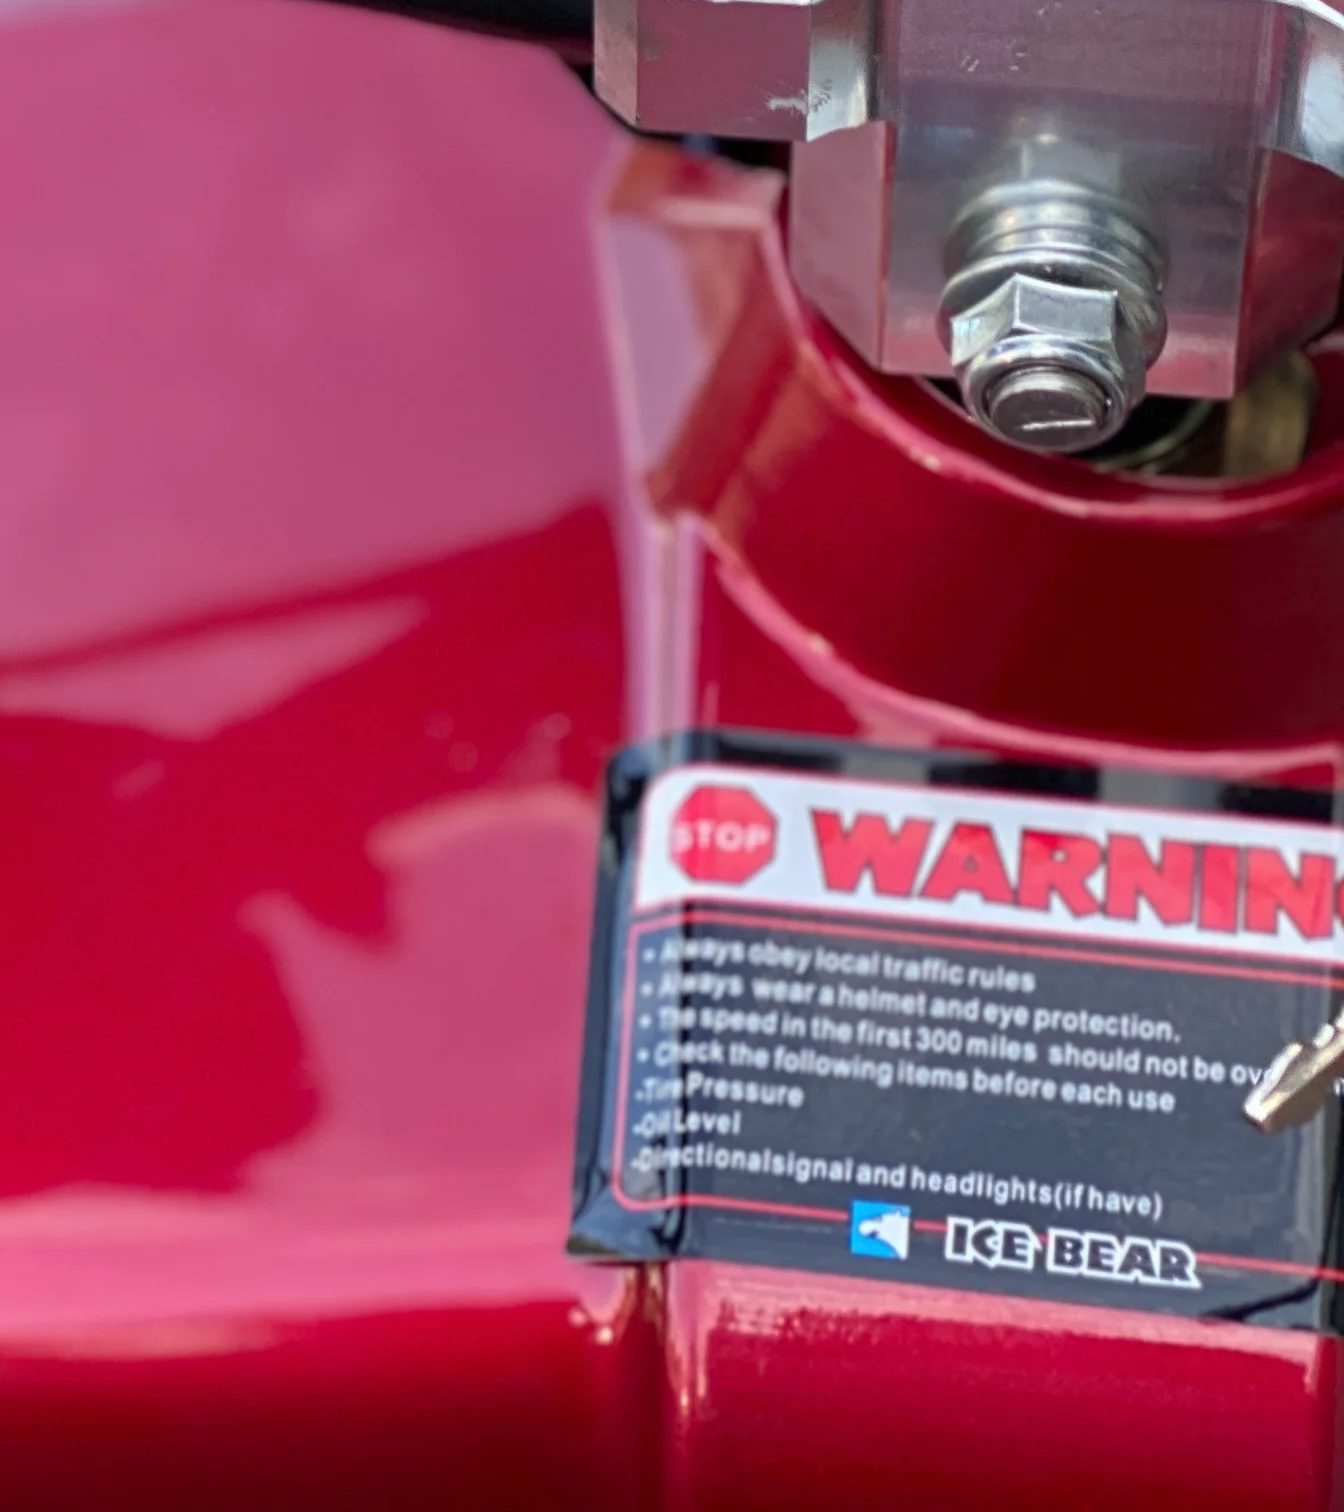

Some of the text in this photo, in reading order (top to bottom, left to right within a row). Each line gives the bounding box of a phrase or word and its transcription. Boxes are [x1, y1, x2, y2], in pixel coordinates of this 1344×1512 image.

[672, 817, 772, 854] STOP
[810, 805, 1344, 942] WARNIN
[748, 940, 812, 975] obey
[815, 945, 879, 976] local
[882, 953, 964, 987] traffic
[968, 965, 1036, 994] rules
[751, 977, 815, 1006] wear
[817, 985, 834, 1008] a
[837, 981, 927, 1016] helmet
[929, 996, 980, 1023] and
[983, 1002, 1030, 1031] eye
[1033, 1006, 1182, 1044] protection.
[699, 1006, 780, 1037] speed
[782, 1012, 806, 1037] in
[810, 1016, 854, 1043] the
[856, 1018, 912, 1050] first
[915, 1024, 963, 1056] 300
[967, 1032, 1038, 1064] miles
[1048, 1041, 1141, 1075] should
[1145, 1054, 1189, 1081] not
[1193, 1055, 1226, 1085] be
[685, 1069, 806, 1109] Pressure
[728, 1041, 770, 1071] the
[772, 1044, 894, 1089] following
[897, 1058, 968, 1092] items
[972, 1066, 1057, 1101] before
[1060, 1079, 1123, 1108] each
[1127, 1090, 1176, 1114] use
[673, 1103, 743, 1137] Level
[855, 1161, 906, 1189] and
[945, 1214, 1203, 1290] ICE BEAR
